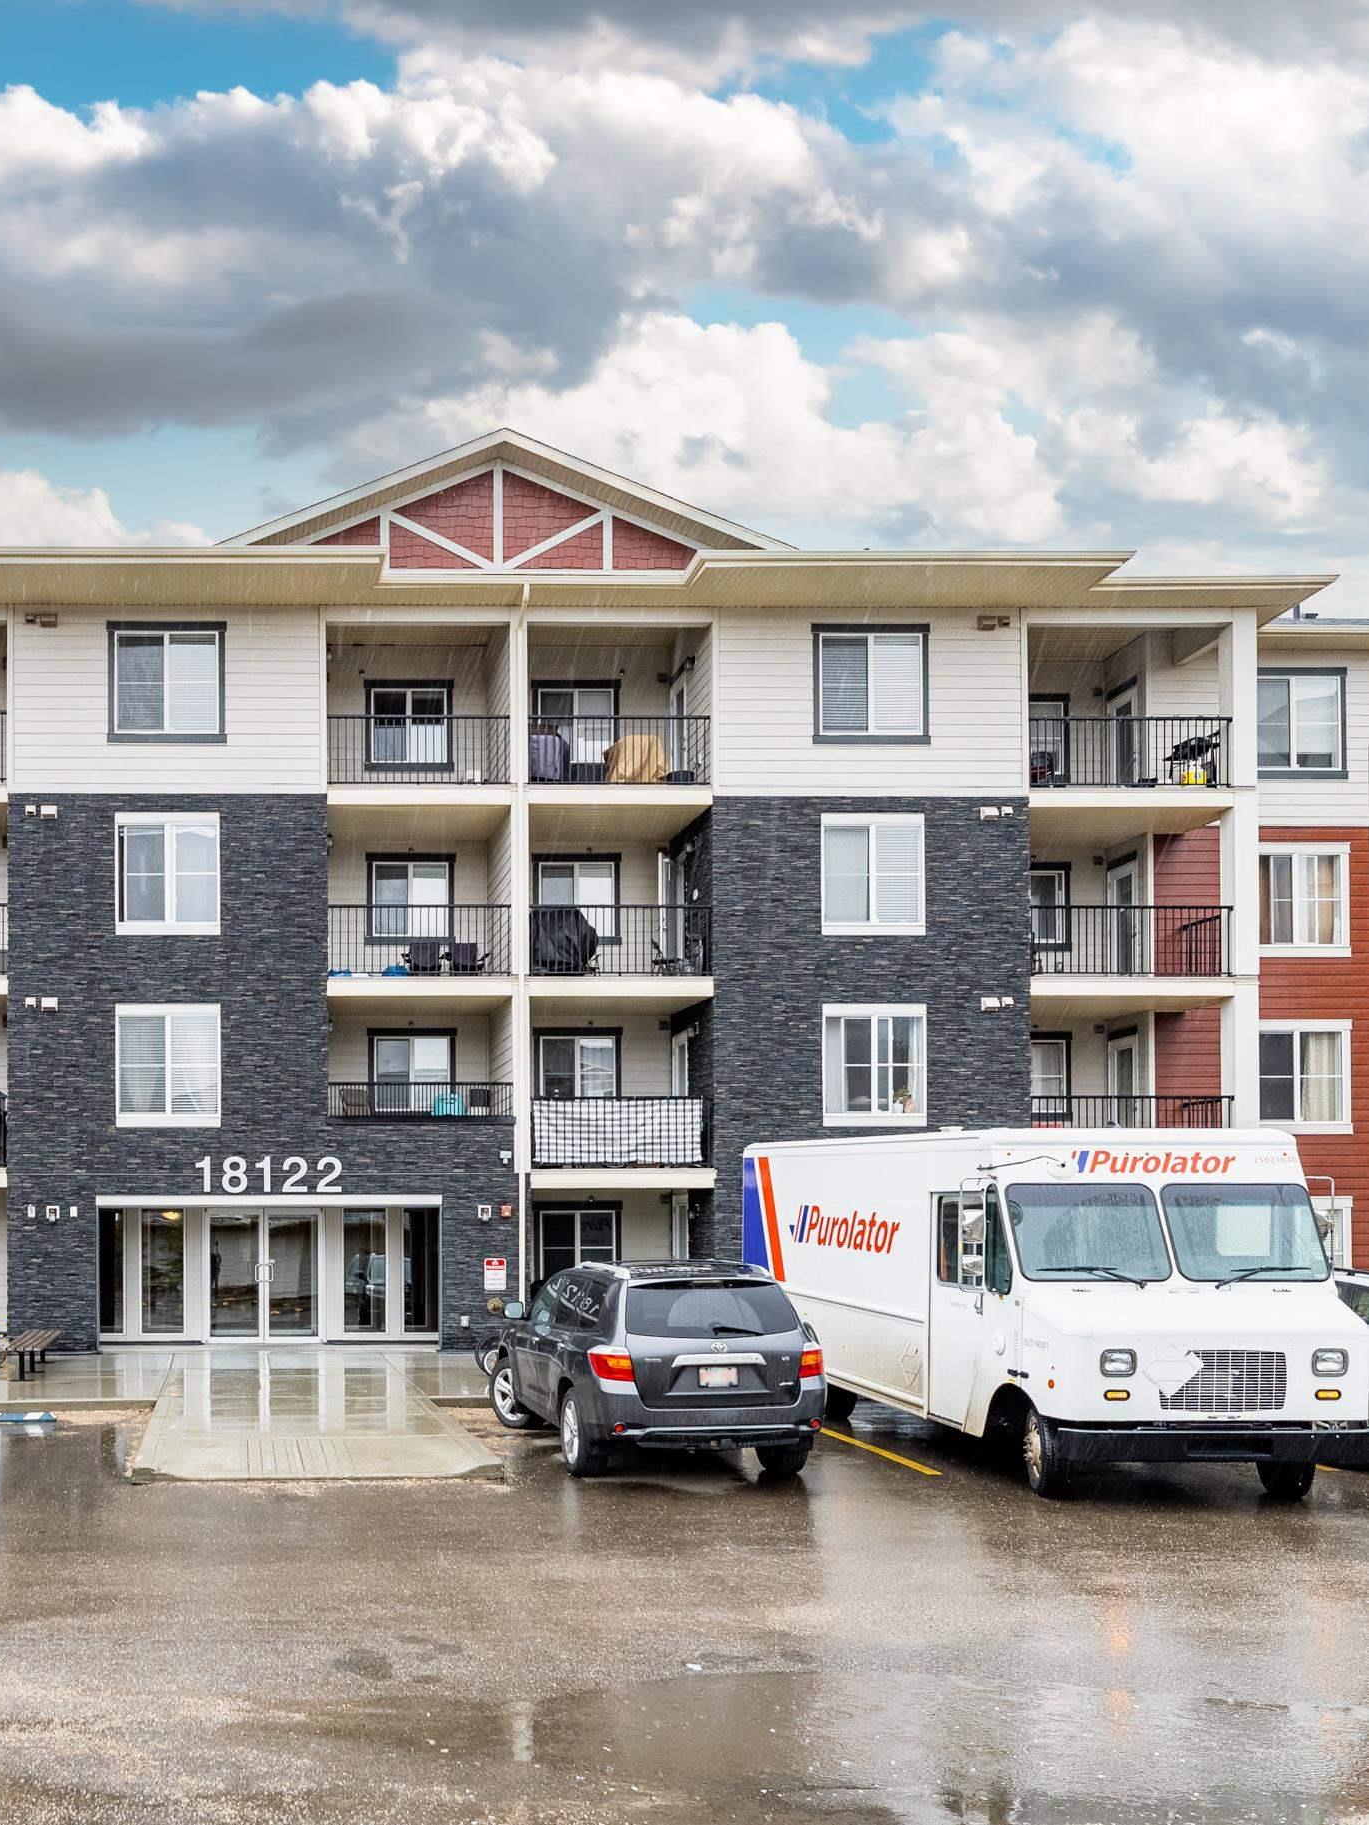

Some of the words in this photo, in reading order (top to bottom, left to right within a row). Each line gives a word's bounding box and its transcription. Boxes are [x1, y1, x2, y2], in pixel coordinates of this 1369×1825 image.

[195, 1155, 343, 1194] 18122
[1089, 1150, 1236, 1174] Purolator
[805, 1205, 901, 1254] Purolator
